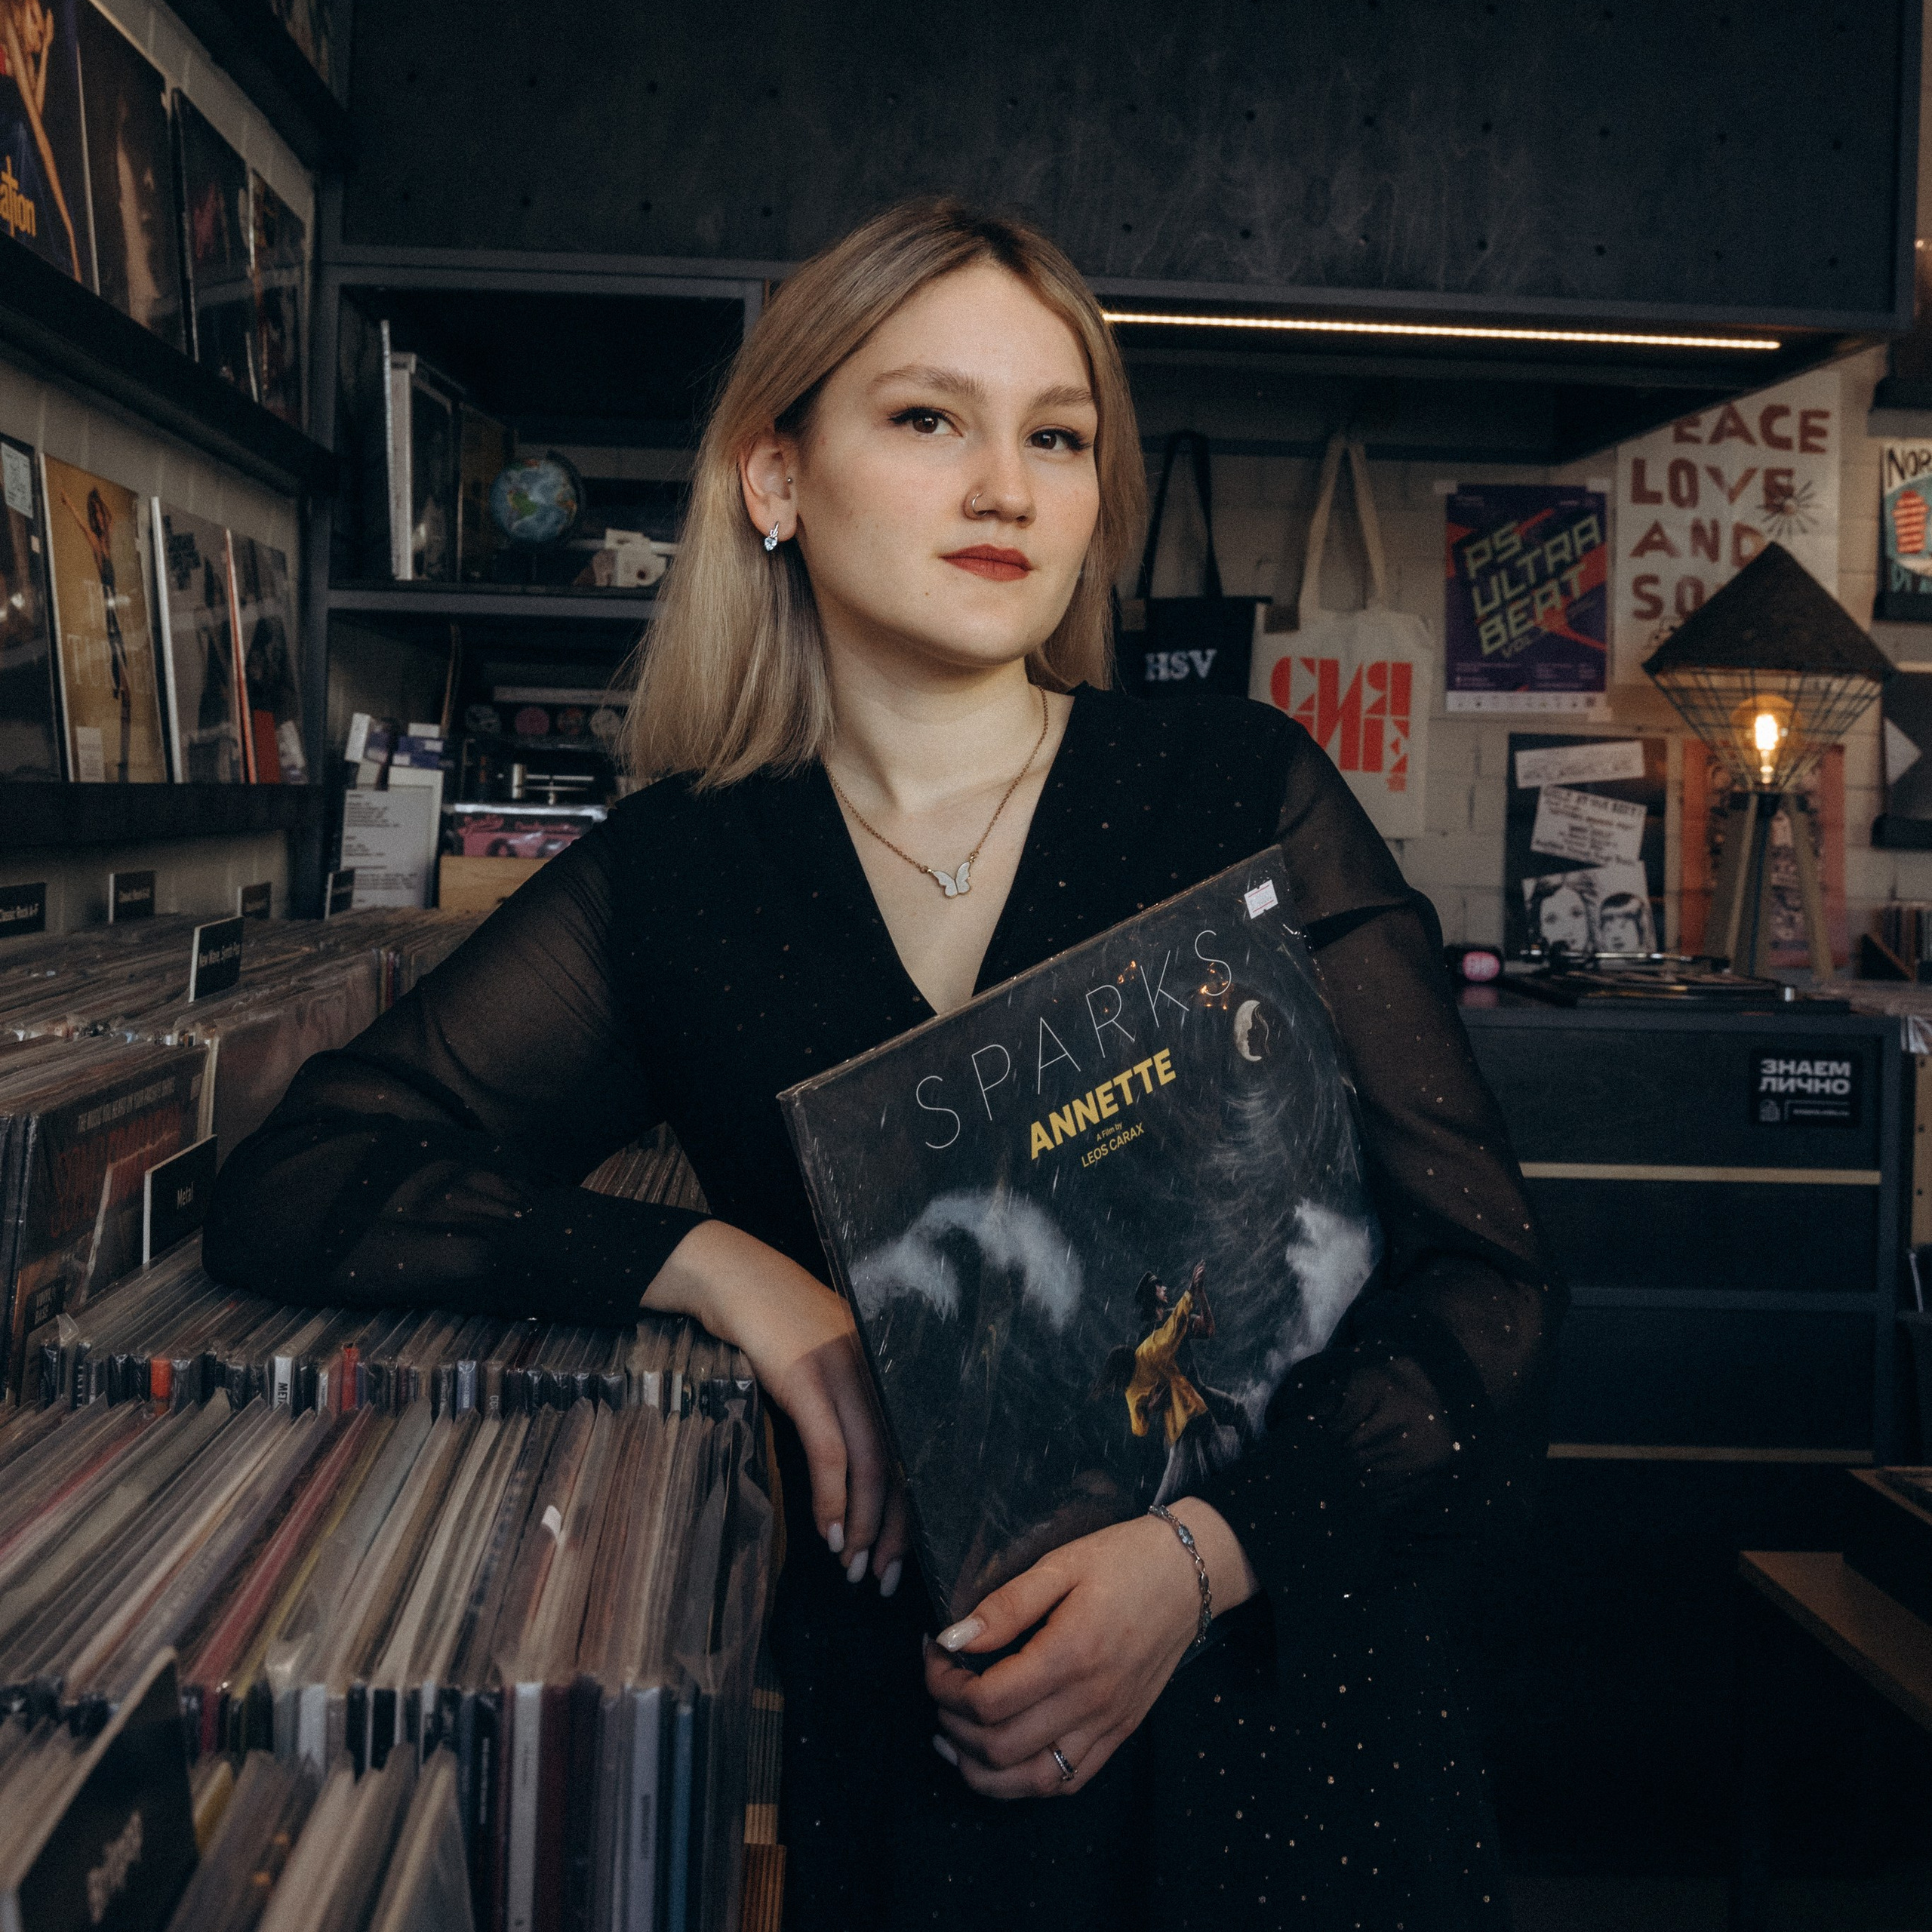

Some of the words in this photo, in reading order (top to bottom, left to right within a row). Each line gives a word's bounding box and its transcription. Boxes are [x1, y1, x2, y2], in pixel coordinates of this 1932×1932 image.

[1673, 402, 1831, 454] EACE
[1630, 457, 1795, 513] LOVE
[1464, 520, 1523, 580] PS
[1472, 514, 1601, 619] ULTRA
[1629, 518, 1767, 569] AND
[1478, 562, 1586, 656] BEAT
[1632, 574, 1705, 621] SO
[1144, 648, 1218, 681] HSV
[915, 929, 1233, 1150] SPARKS
[1758, 1076, 1851, 1095] ЛИЧНО
[1760, 1058, 1851, 1078] ЗНАЕМ
[1030, 1047, 1177, 1161] ANNETTE
[1081, 1143, 1109, 1168] LEOS
[1108, 1121, 1145, 1152] CARAX
[1096, 1133, 1102, 1142] A
[1101, 1124, 1117, 1139] Film
[1115, 1121, 1123, 1131] by
[177, 1180, 195, 1211] Metal
